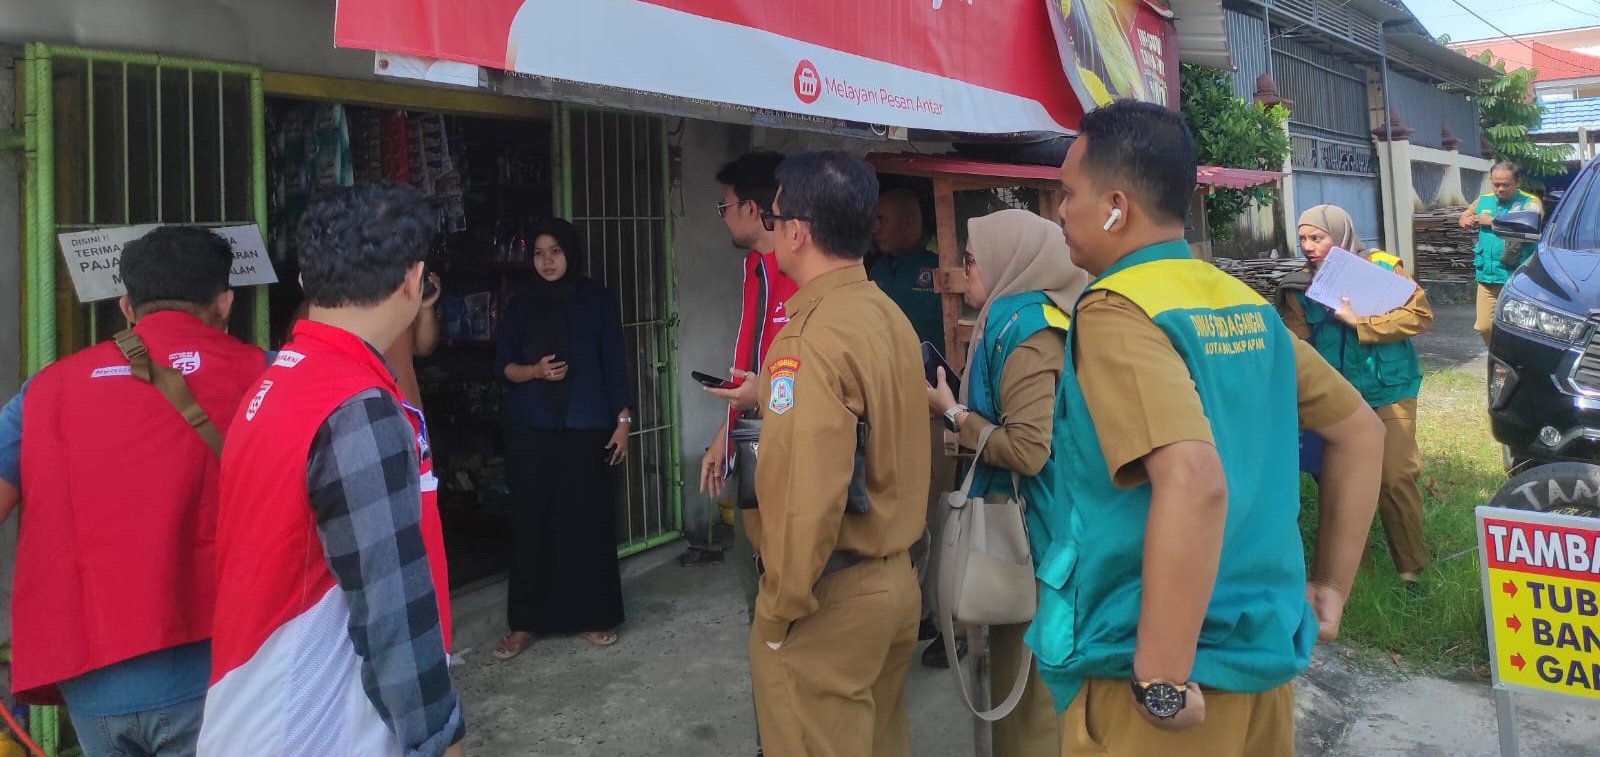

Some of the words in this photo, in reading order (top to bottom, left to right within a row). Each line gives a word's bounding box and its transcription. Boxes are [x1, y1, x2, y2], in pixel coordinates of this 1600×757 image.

[825, 76, 878, 105] Melayani
[880, 88, 914, 111] Pesan
[916, 97, 944, 115] Antar
[71, 236, 101, 247] DISINI
[75, 244, 121, 258] TERIMA
[80, 257, 121, 273] PAJA
